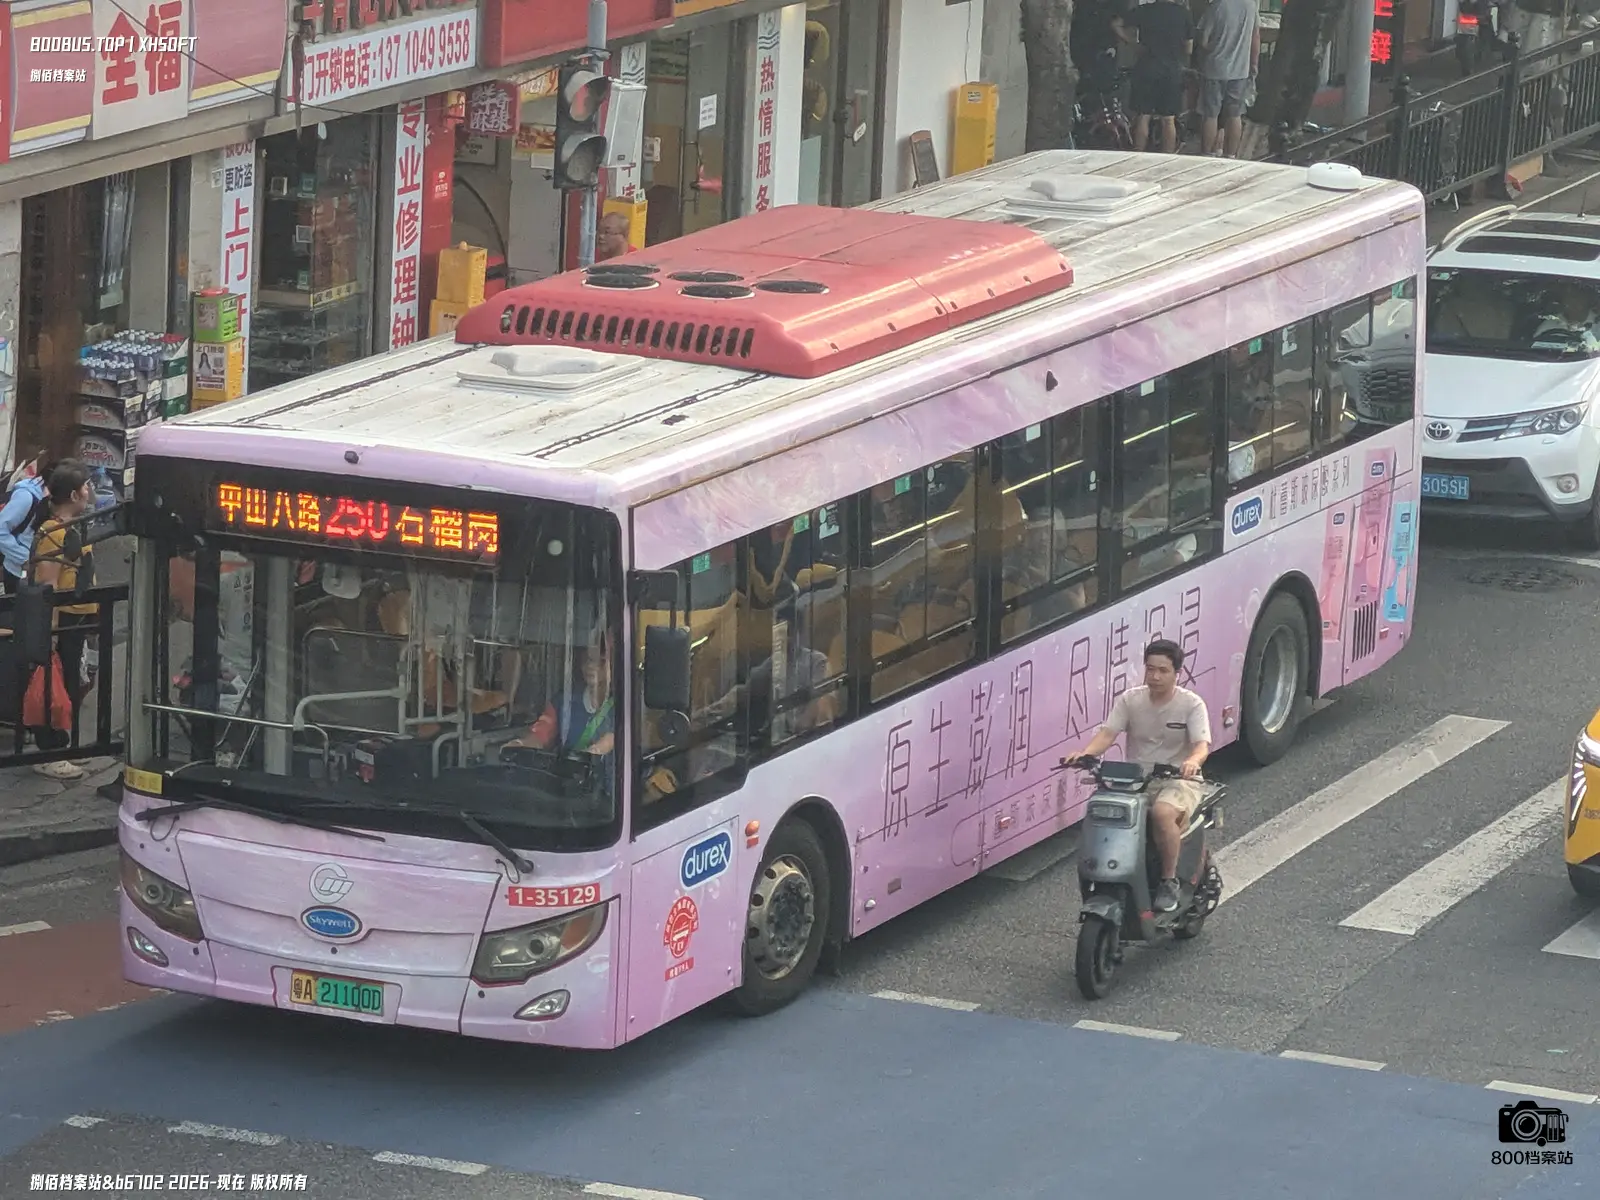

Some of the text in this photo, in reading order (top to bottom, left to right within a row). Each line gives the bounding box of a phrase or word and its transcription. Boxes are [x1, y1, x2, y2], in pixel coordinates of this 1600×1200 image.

[405, 26, 435, 75] 1049
[439, 18, 470, 68] 9558
[1232, 499, 1262, 530] durex
[685, 840, 729, 880] durex
[514, 886, 596, 906] 1-35129
